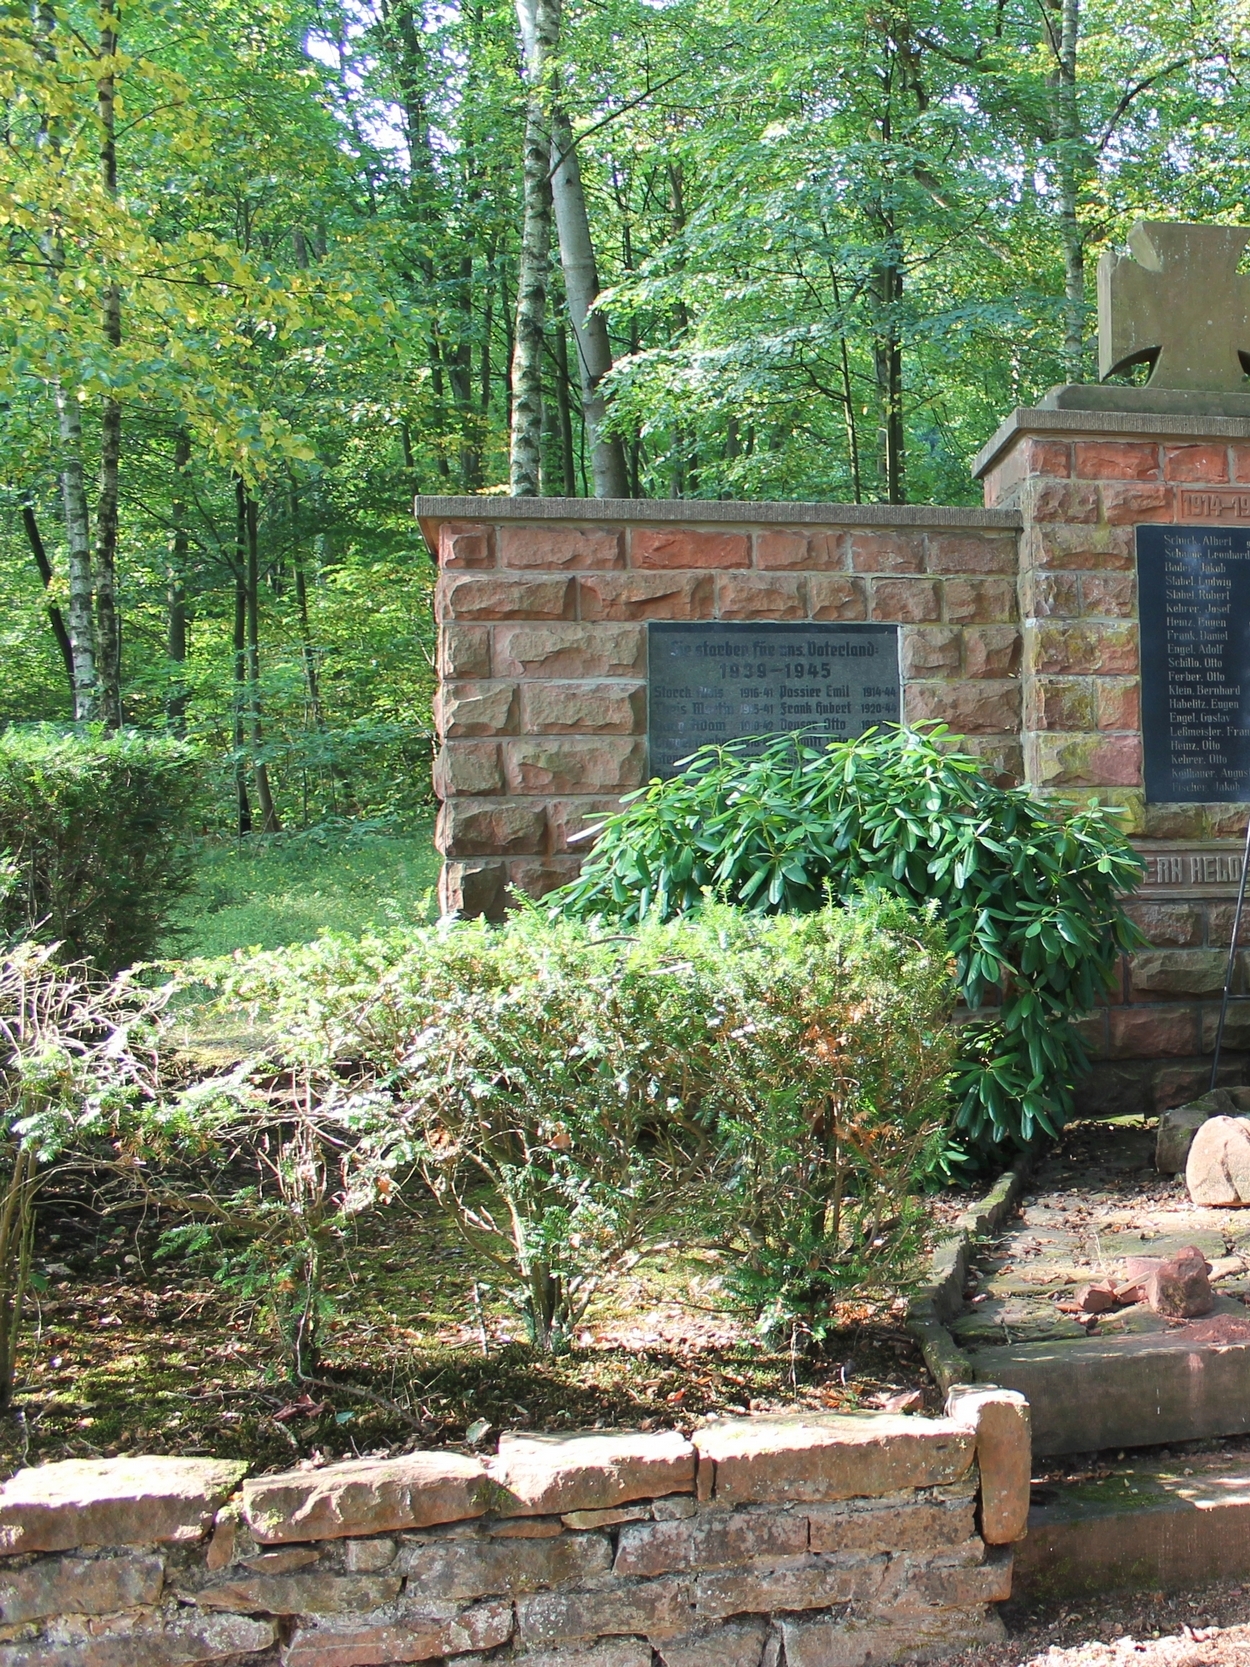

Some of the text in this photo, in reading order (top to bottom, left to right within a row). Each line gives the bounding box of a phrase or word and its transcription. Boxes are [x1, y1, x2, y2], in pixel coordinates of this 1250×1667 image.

[1203, 536, 1232, 546] Albert
[1207, 550, 1250, 560] Leonhard
[1201, 562, 1226, 573] Jakob
[1199, 590, 1230, 601] Robert
[1205, 603, 1231, 614] Josef
[1198, 617, 1227, 630] Eugen
[1200, 631, 1228, 641] Daniel
[695, 641, 749, 657] starben
[752, 640, 776, 659] für
[1199, 645, 1224, 655] Adolf
[1204, 658, 1222, 668] Otto
[719, 662, 831, 680] 1939-1945
[1206, 671, 1225, 682] Otto
[740, 686, 773, 698] 1916-41
[826, 684, 851, 698] Emil
[862, 686, 897, 698] 1914-44
[1197, 685, 1241, 696] Bernhard
[780, 701, 813, 716] Frank
[815, 701, 852, 716] Hubert
[1211, 699, 1239, 711] Eugen
[1200, 712, 1230, 723] Gustav
[1201, 740, 1220, 751] Otto
[1209, 754, 1228, 765] Otto
